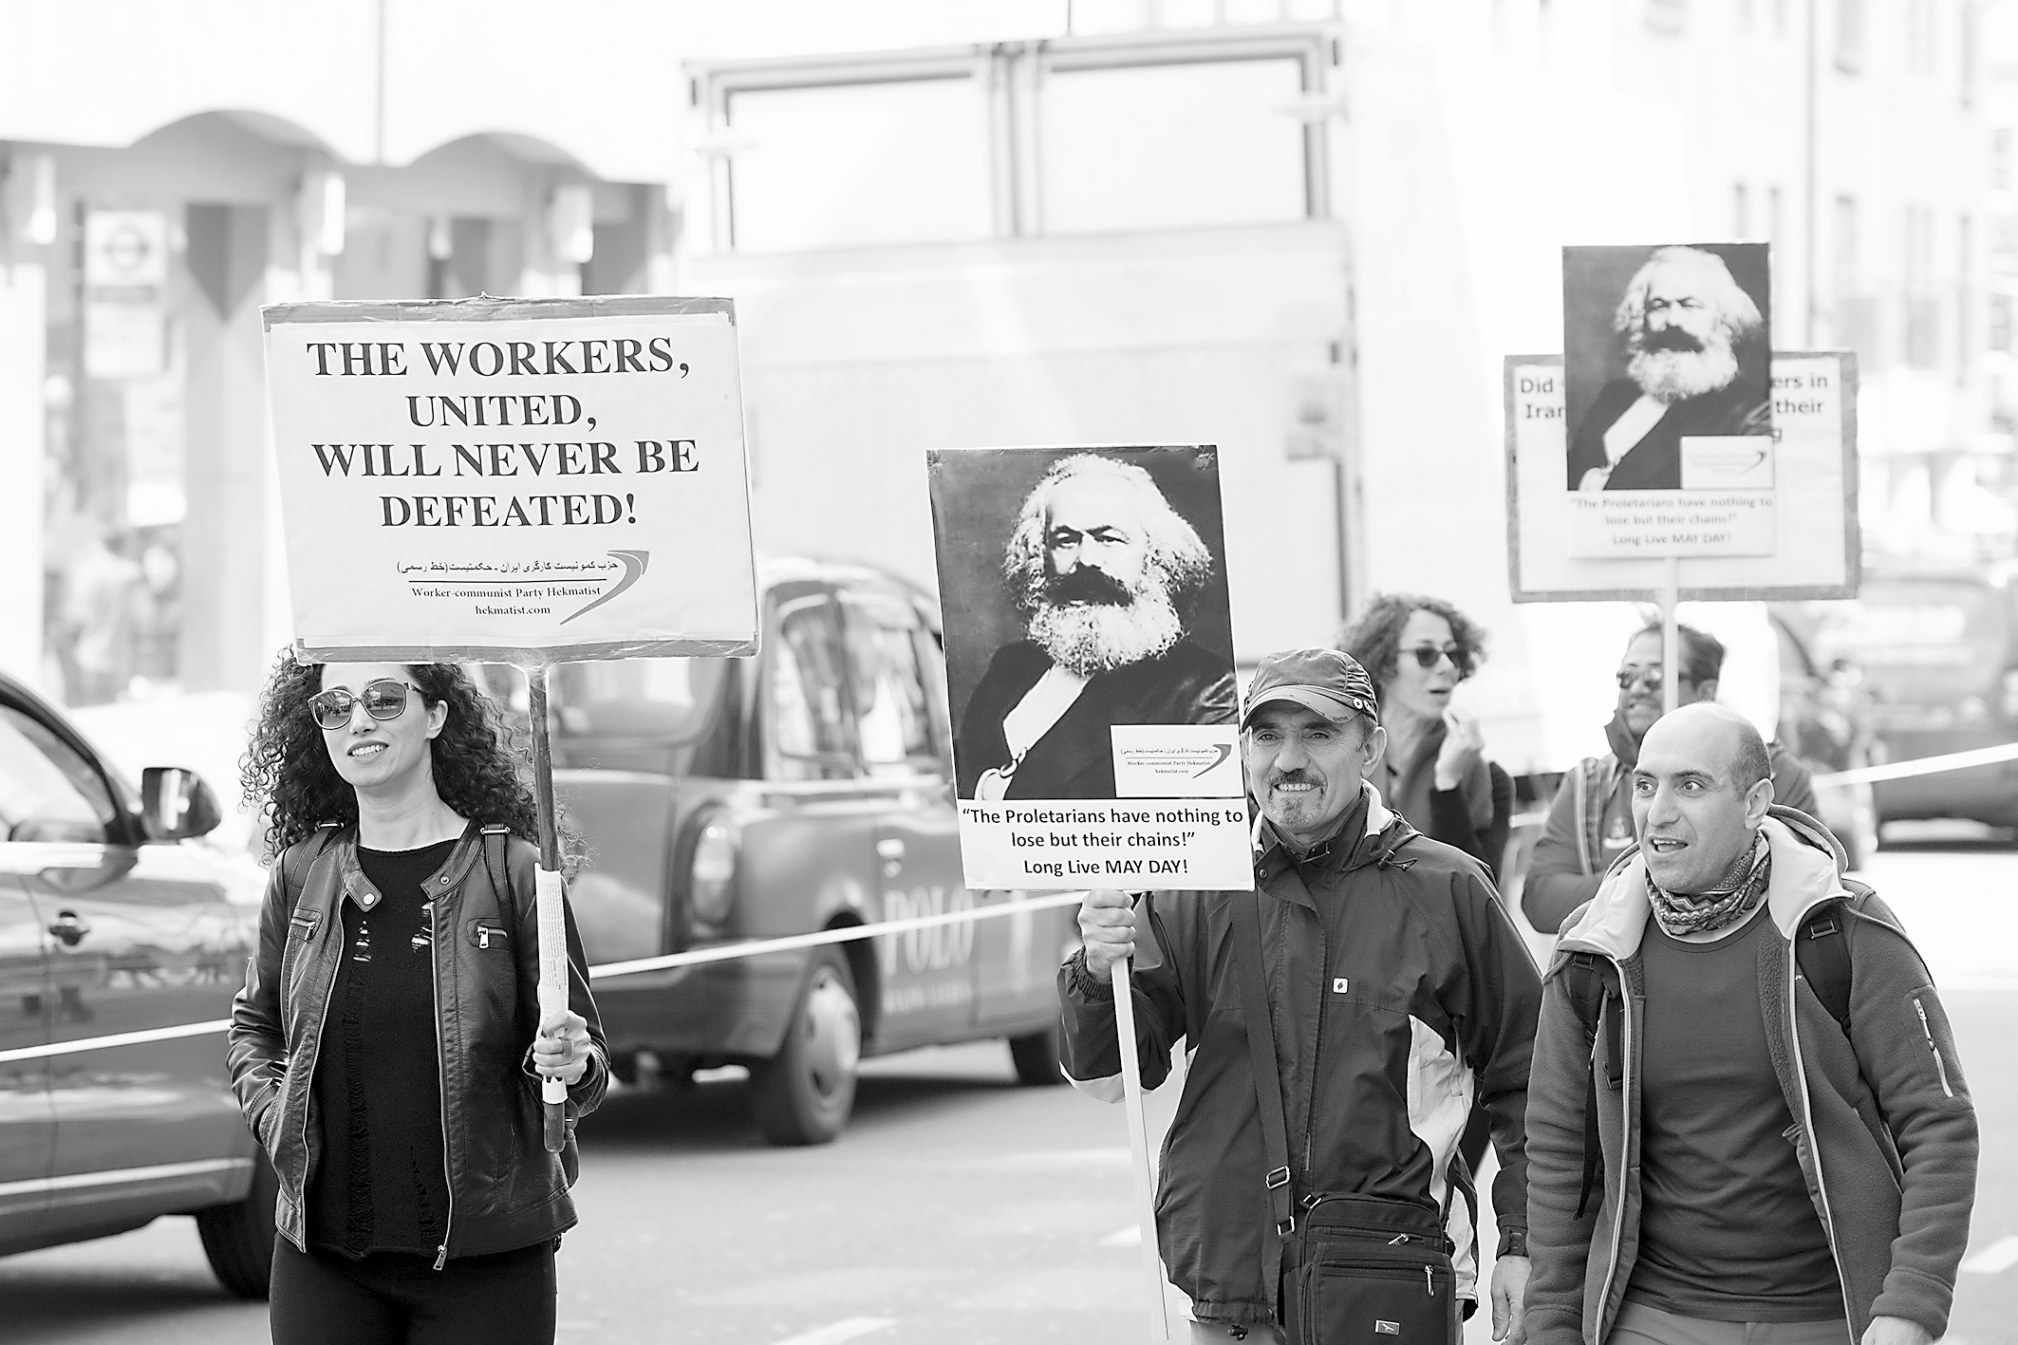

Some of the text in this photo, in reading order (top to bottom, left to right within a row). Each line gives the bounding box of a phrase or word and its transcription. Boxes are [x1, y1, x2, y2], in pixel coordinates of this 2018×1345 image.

[306, 337, 689, 379] THE WORKERS,
[1521, 378, 1553, 393] Did
[1772, 372, 1828, 389] ers in
[405, 394, 597, 432] UNITED,
[1776, 398, 1825, 414] their
[311, 439, 700, 477] WILL NEVER BE
[1760, 497, 1773, 506] to
[379, 493, 637, 527] DEFEATED!
[1634, 516, 1652, 524] but
[1657, 515, 1685, 524] their
[1613, 535, 1640, 546] Long
[1645, 534, 1668, 544] Live
[1672, 534, 1699, 543] MAY
[597, 560, 619, 571] حزب
[411, 586, 601, 600] Worker-communist Party Hekmatist
[475, 605, 551, 615] hekmatist.com
[962, 807, 1244, 827] “The Proletarians have nothing to
[1011, 831, 1195, 848] lose but their chains!”
[1023, 858, 1188, 878] Long Live MAY DAY!
